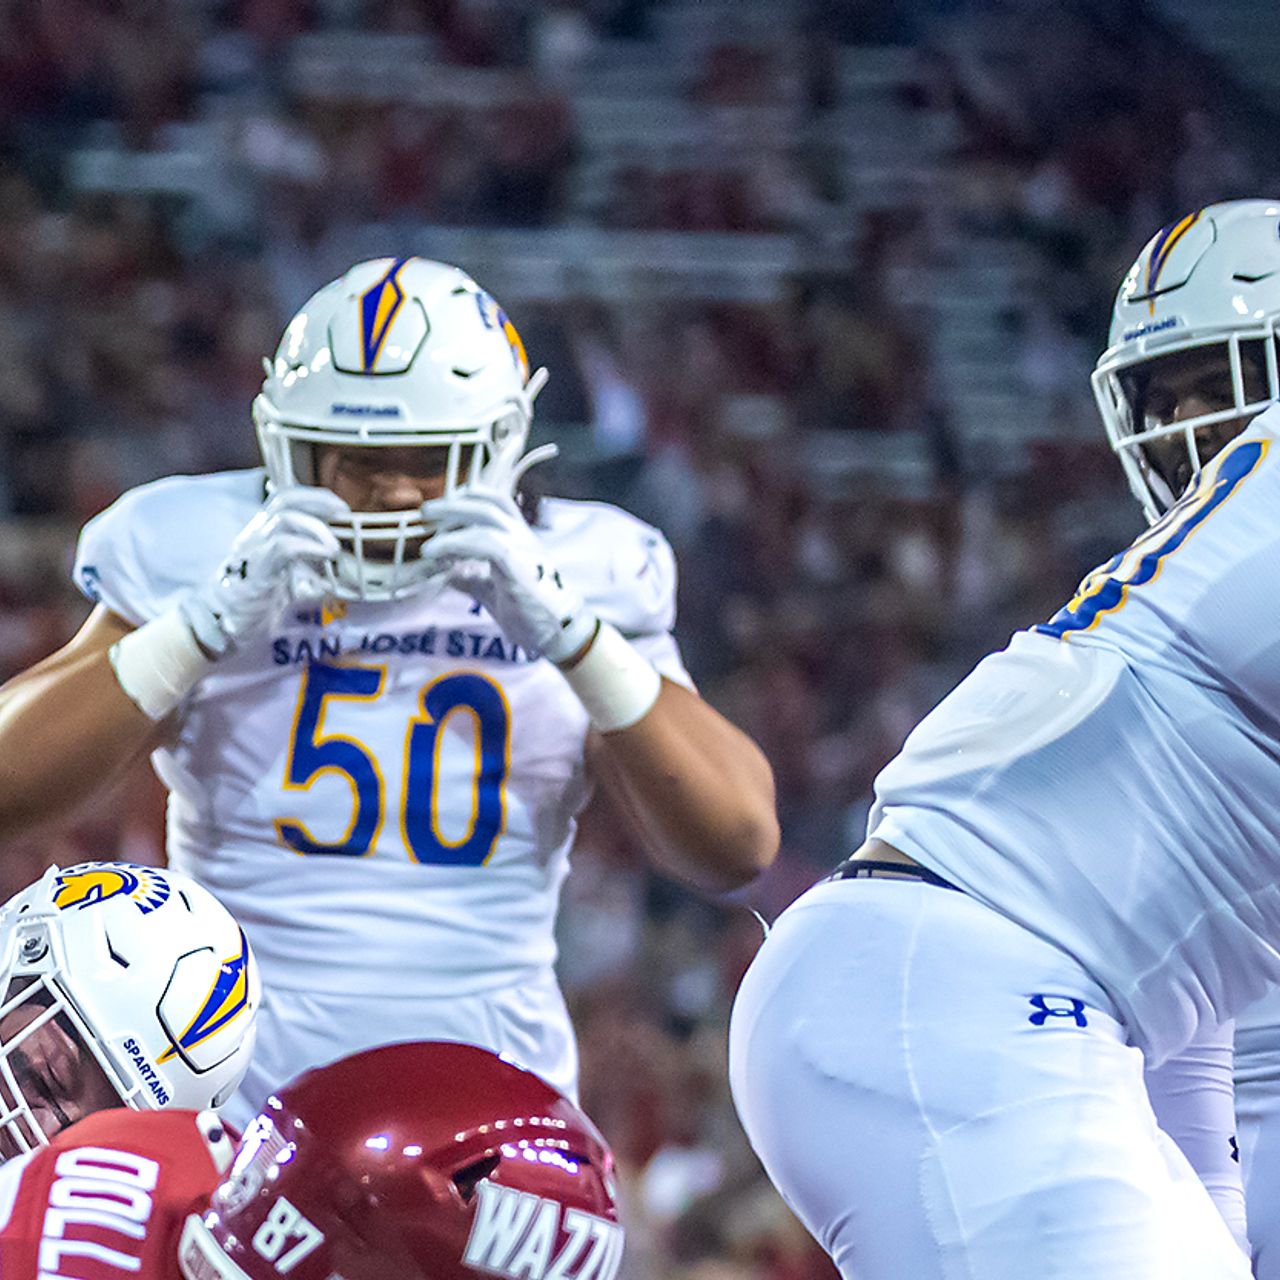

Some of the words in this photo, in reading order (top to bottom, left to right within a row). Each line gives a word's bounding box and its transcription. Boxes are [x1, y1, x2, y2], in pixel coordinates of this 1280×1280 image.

[273, 635, 341, 665] SAN
[446, 630, 544, 663] STA
[272, 660, 513, 868] 50
[122, 1038, 171, 1107] SPARTANS
[251, 1196, 326, 1275] 87
